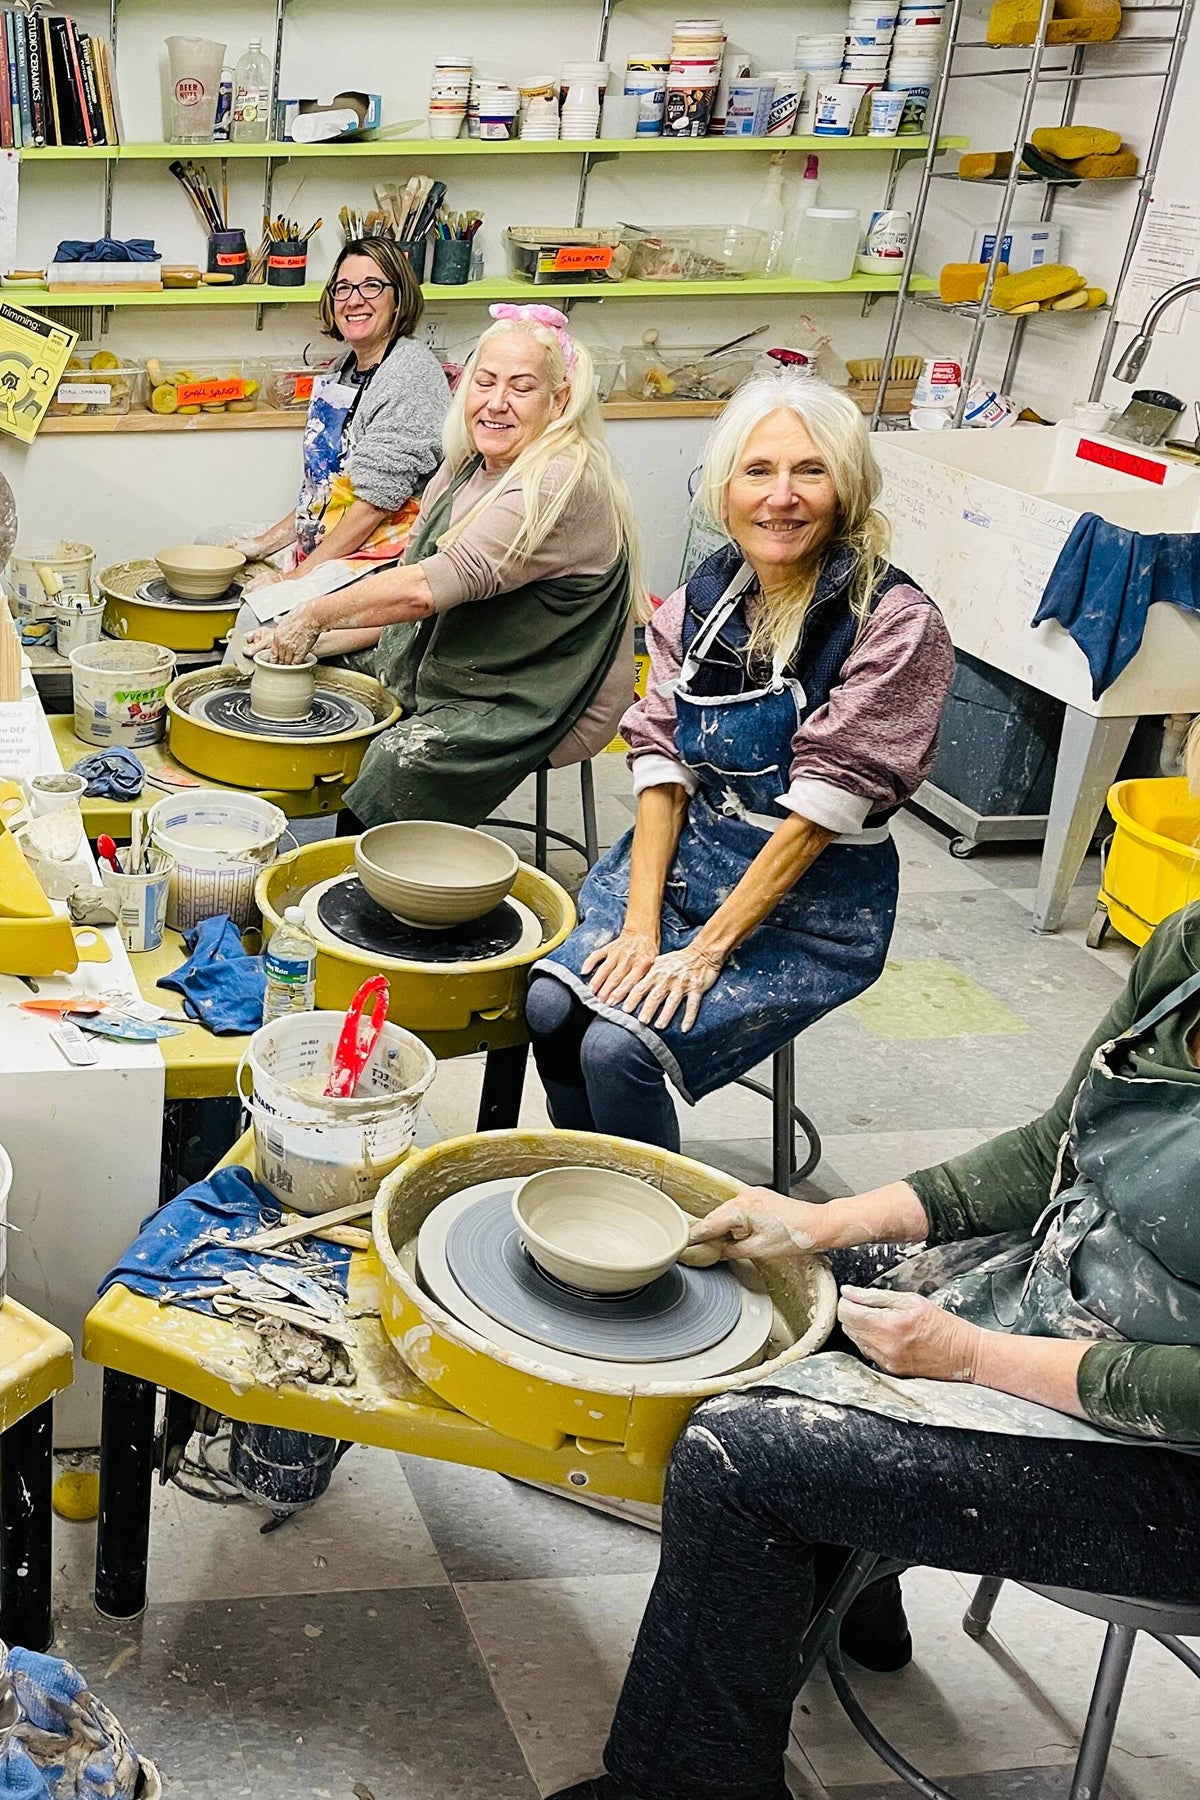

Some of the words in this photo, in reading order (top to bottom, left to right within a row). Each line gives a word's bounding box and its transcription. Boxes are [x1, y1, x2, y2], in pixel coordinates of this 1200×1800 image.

[28, 16, 38, 53] STUDIO
[30, 53, 41, 101] CERAMICS
[179, 83, 198, 91] BEER
[1, 305, 41, 331] Trimming:
[184, 388, 207, 399] SMALL
